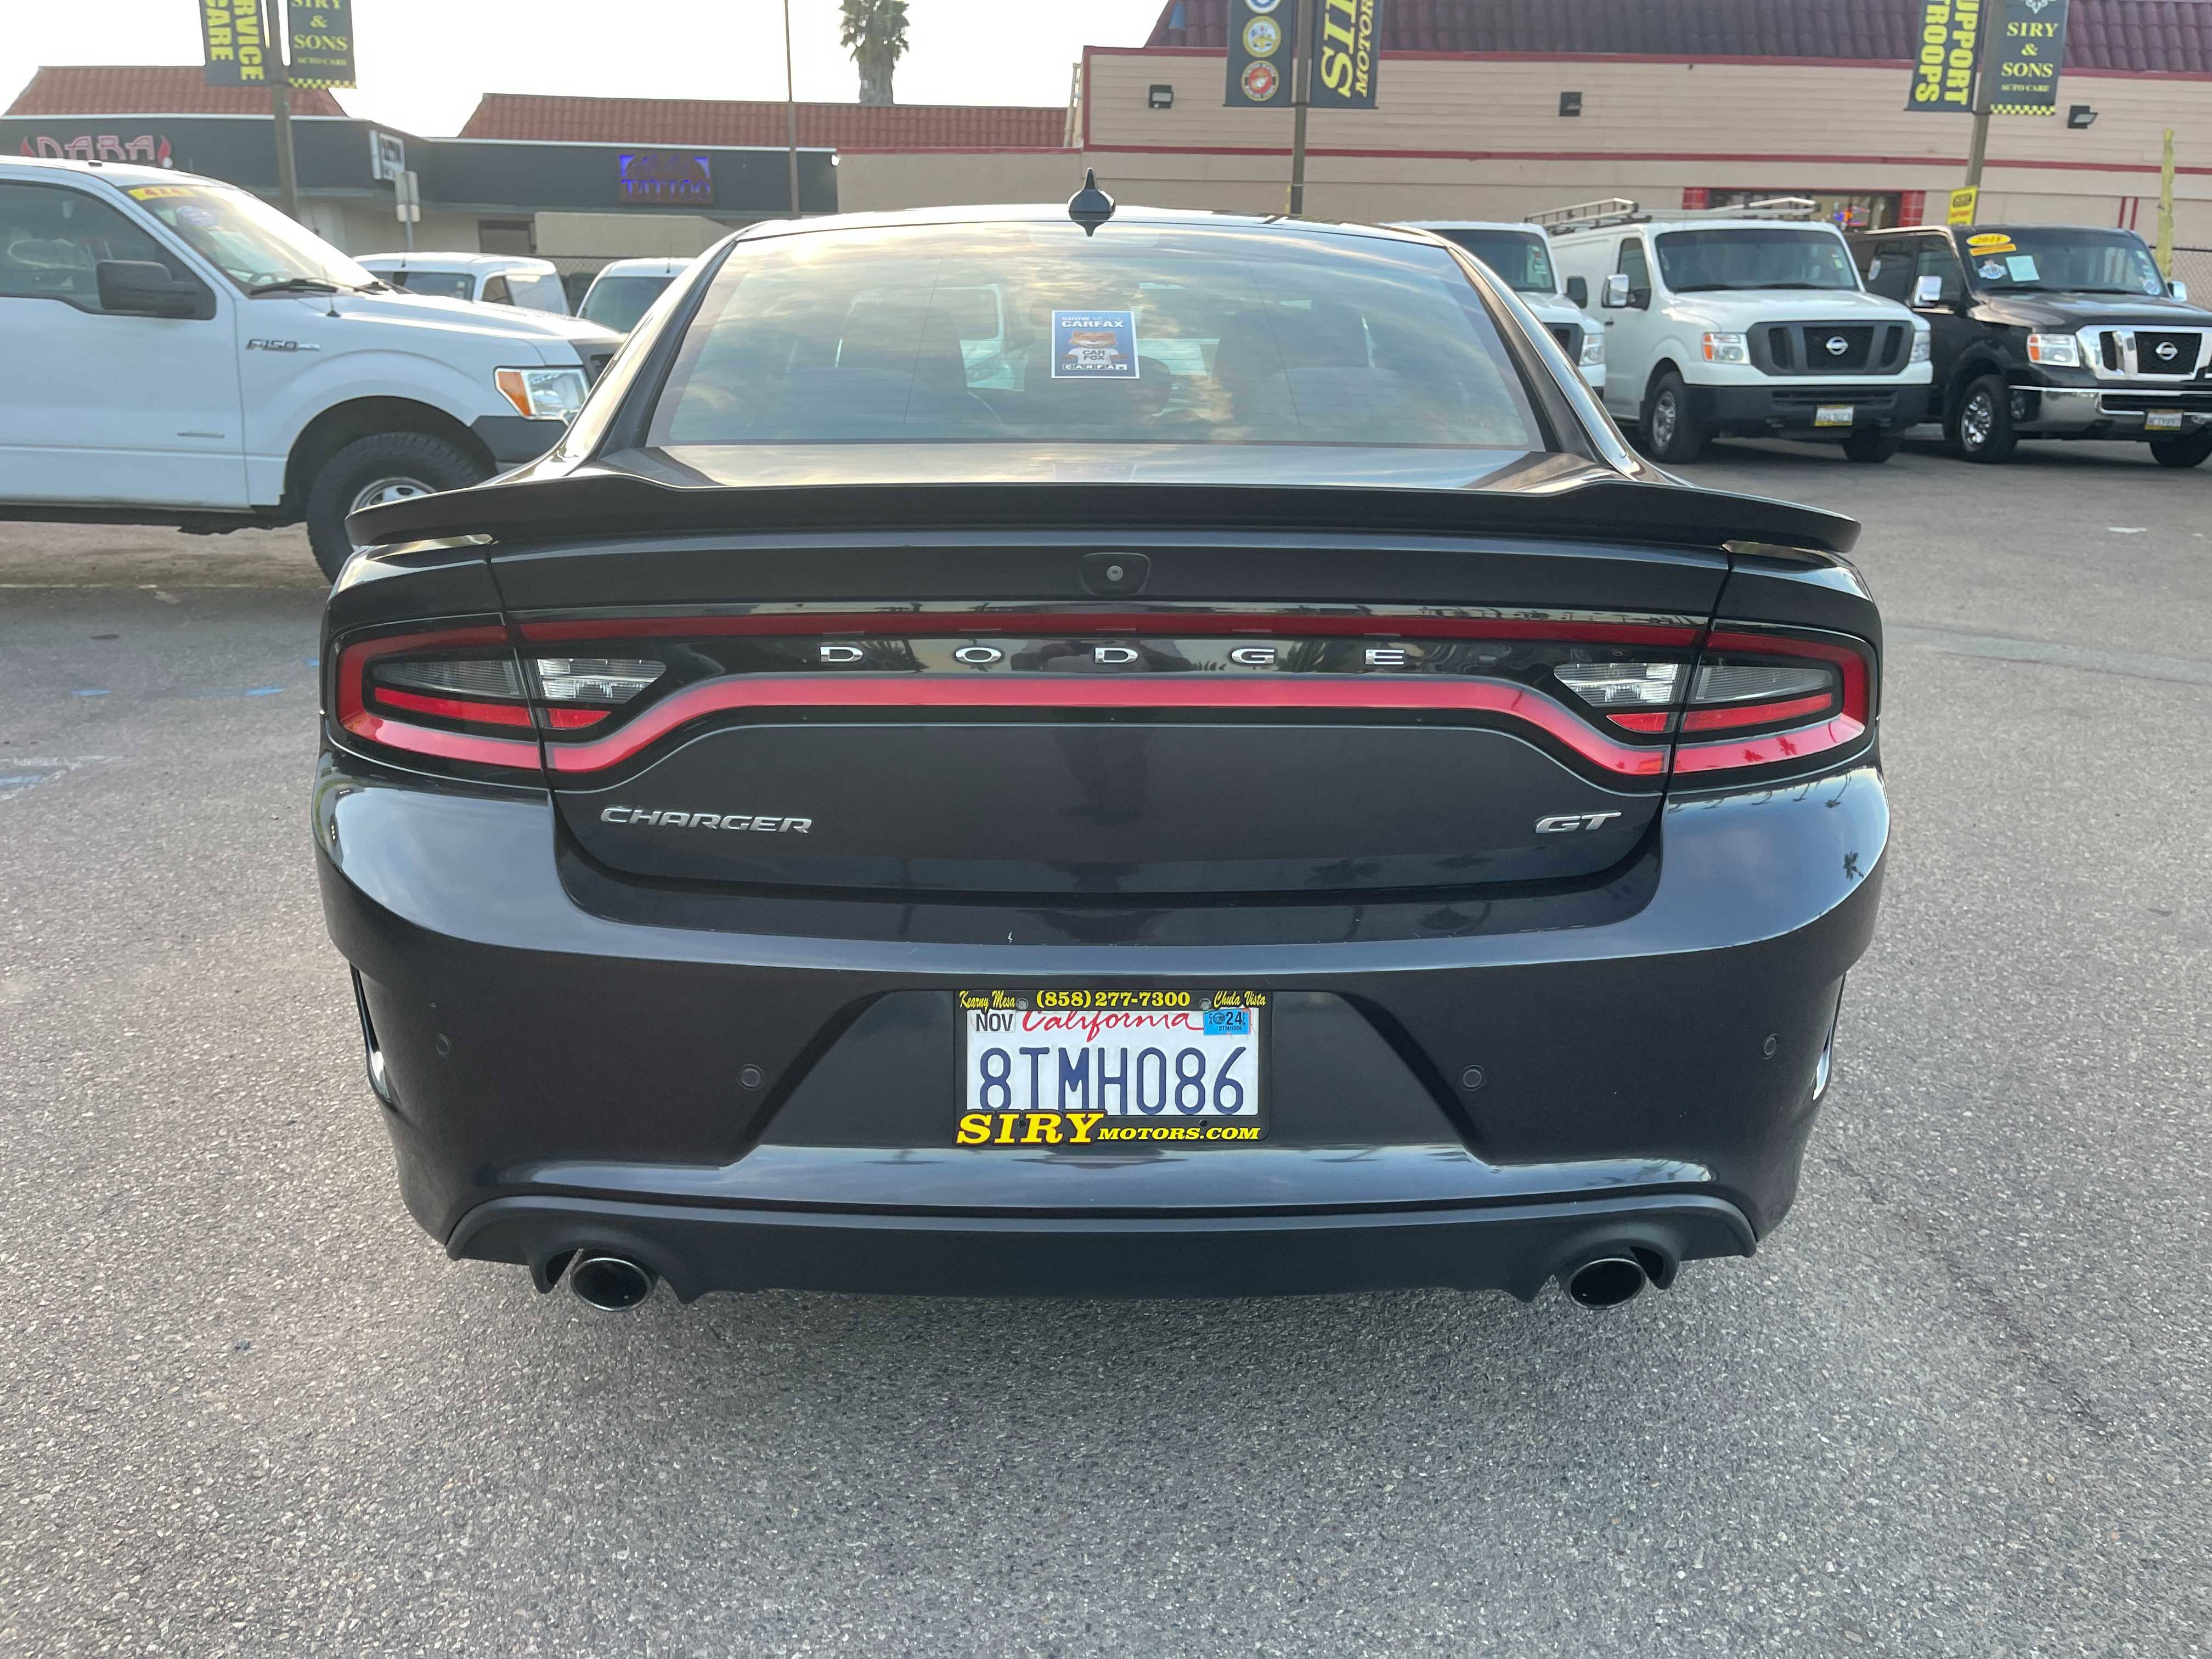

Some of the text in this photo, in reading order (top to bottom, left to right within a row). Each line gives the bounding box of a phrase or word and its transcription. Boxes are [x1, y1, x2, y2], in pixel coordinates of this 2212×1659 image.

[310, 15, 328, 28] &
[2006, 21, 2059, 37] SIRY
[294, 34, 348, 50] SONS
[2021, 43, 2038, 56] &
[2001, 61, 2054, 78] SONS
[820, 645, 1405, 665] DODGE
[600, 807, 812, 833] CHARGER
[1535, 811, 1622, 833] GT
[959, 990, 1016, 1013] Kearny Mesa
[1036, 990, 1191, 1008] (858) 277-7300
[1214, 990, 1266, 1008] Chula Vista
[976, 1013, 1013, 1032] NOV
[1022, 1010, 1204, 1043] California
[1226, 1011, 1243, 1025] 24
[979, 1046, 1246, 1115] 8TMH086
[957, 1113, 1261, 1144] SIRY MOTORS.COM
